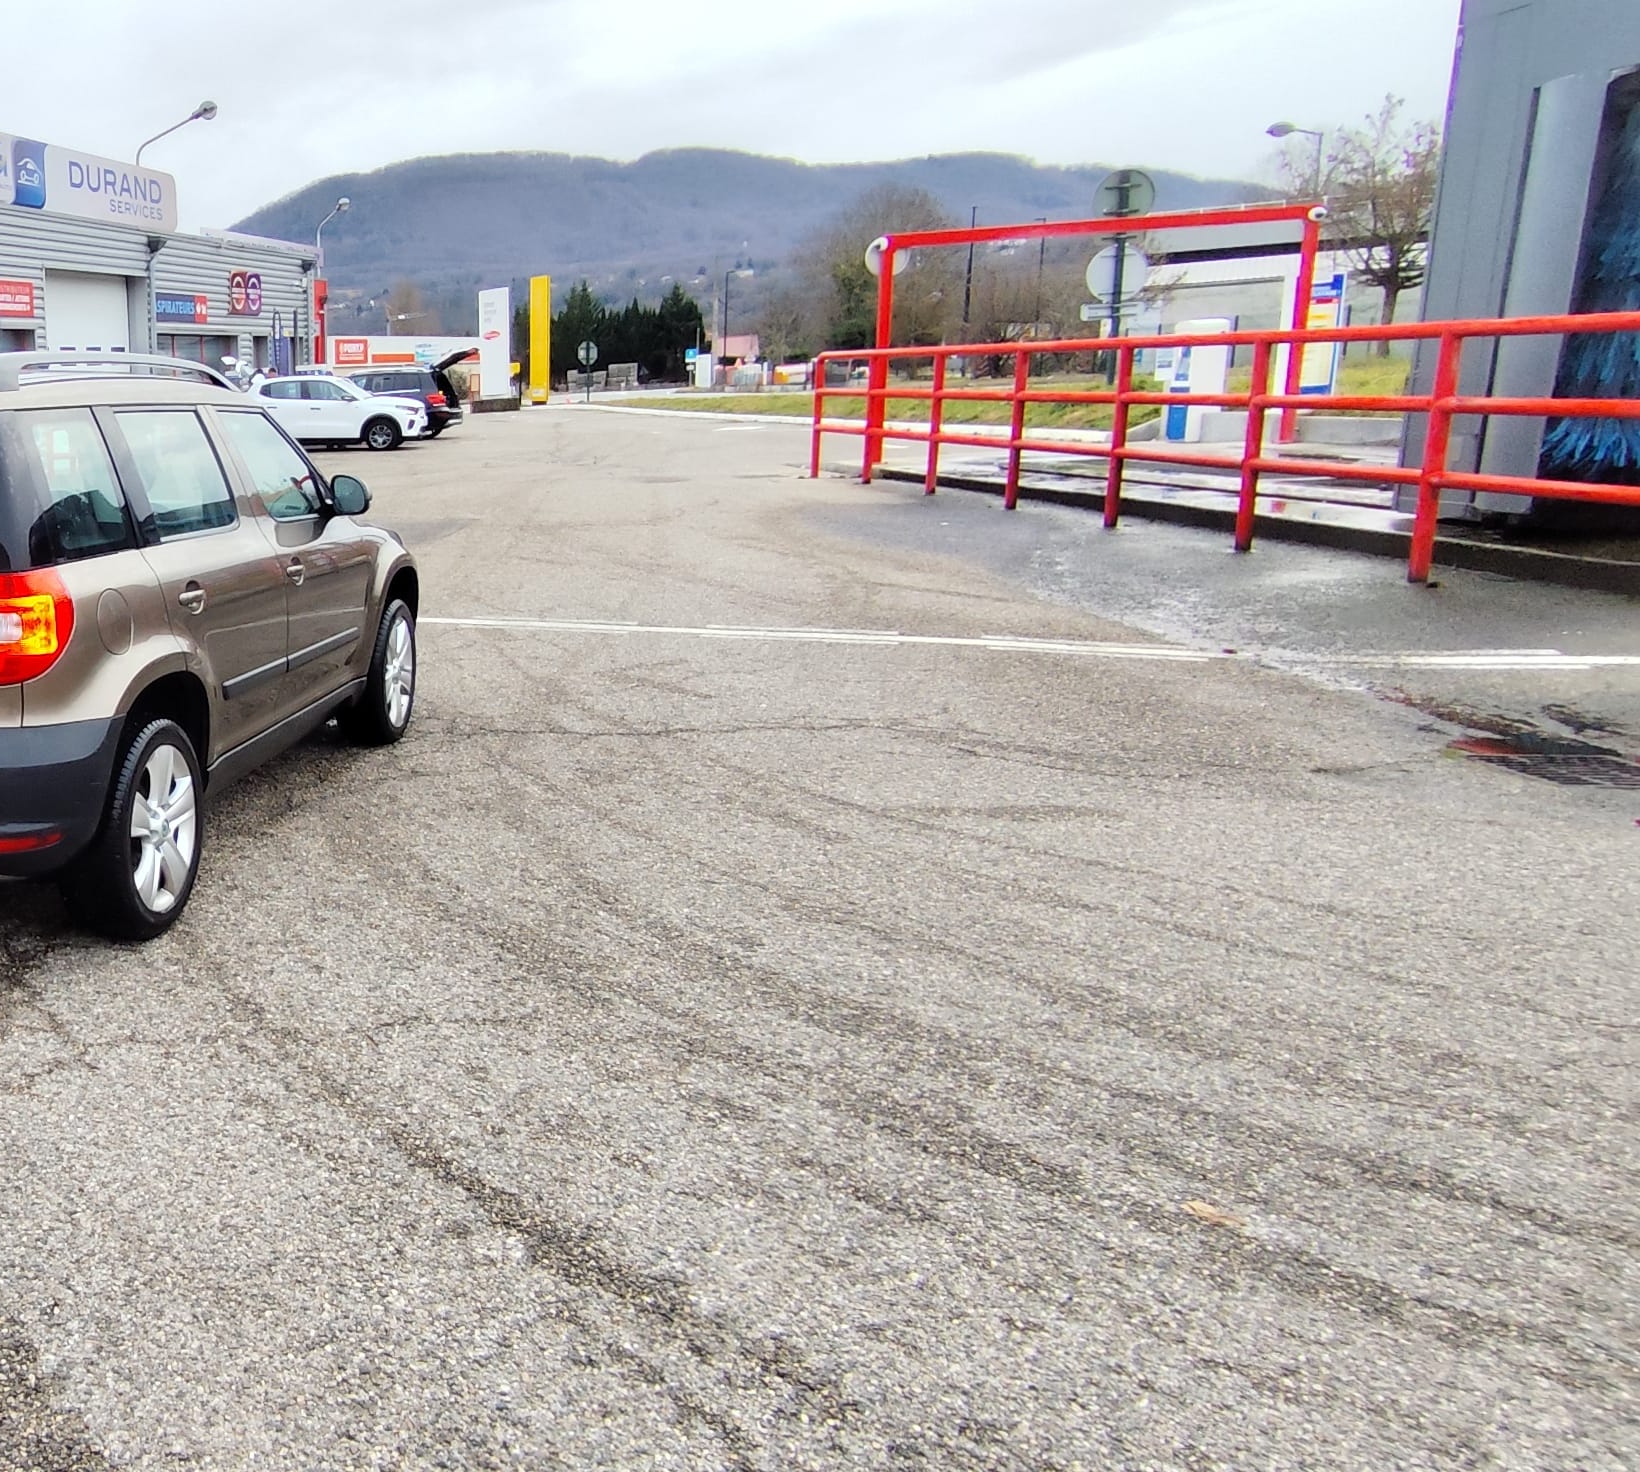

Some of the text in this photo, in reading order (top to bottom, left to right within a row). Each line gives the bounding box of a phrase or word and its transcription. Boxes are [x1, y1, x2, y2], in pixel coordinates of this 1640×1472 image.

[68, 160, 162, 204] DURAND
[110, 199, 163, 221] SERVICES
[156, 300, 195, 315] SPIRATEURS
